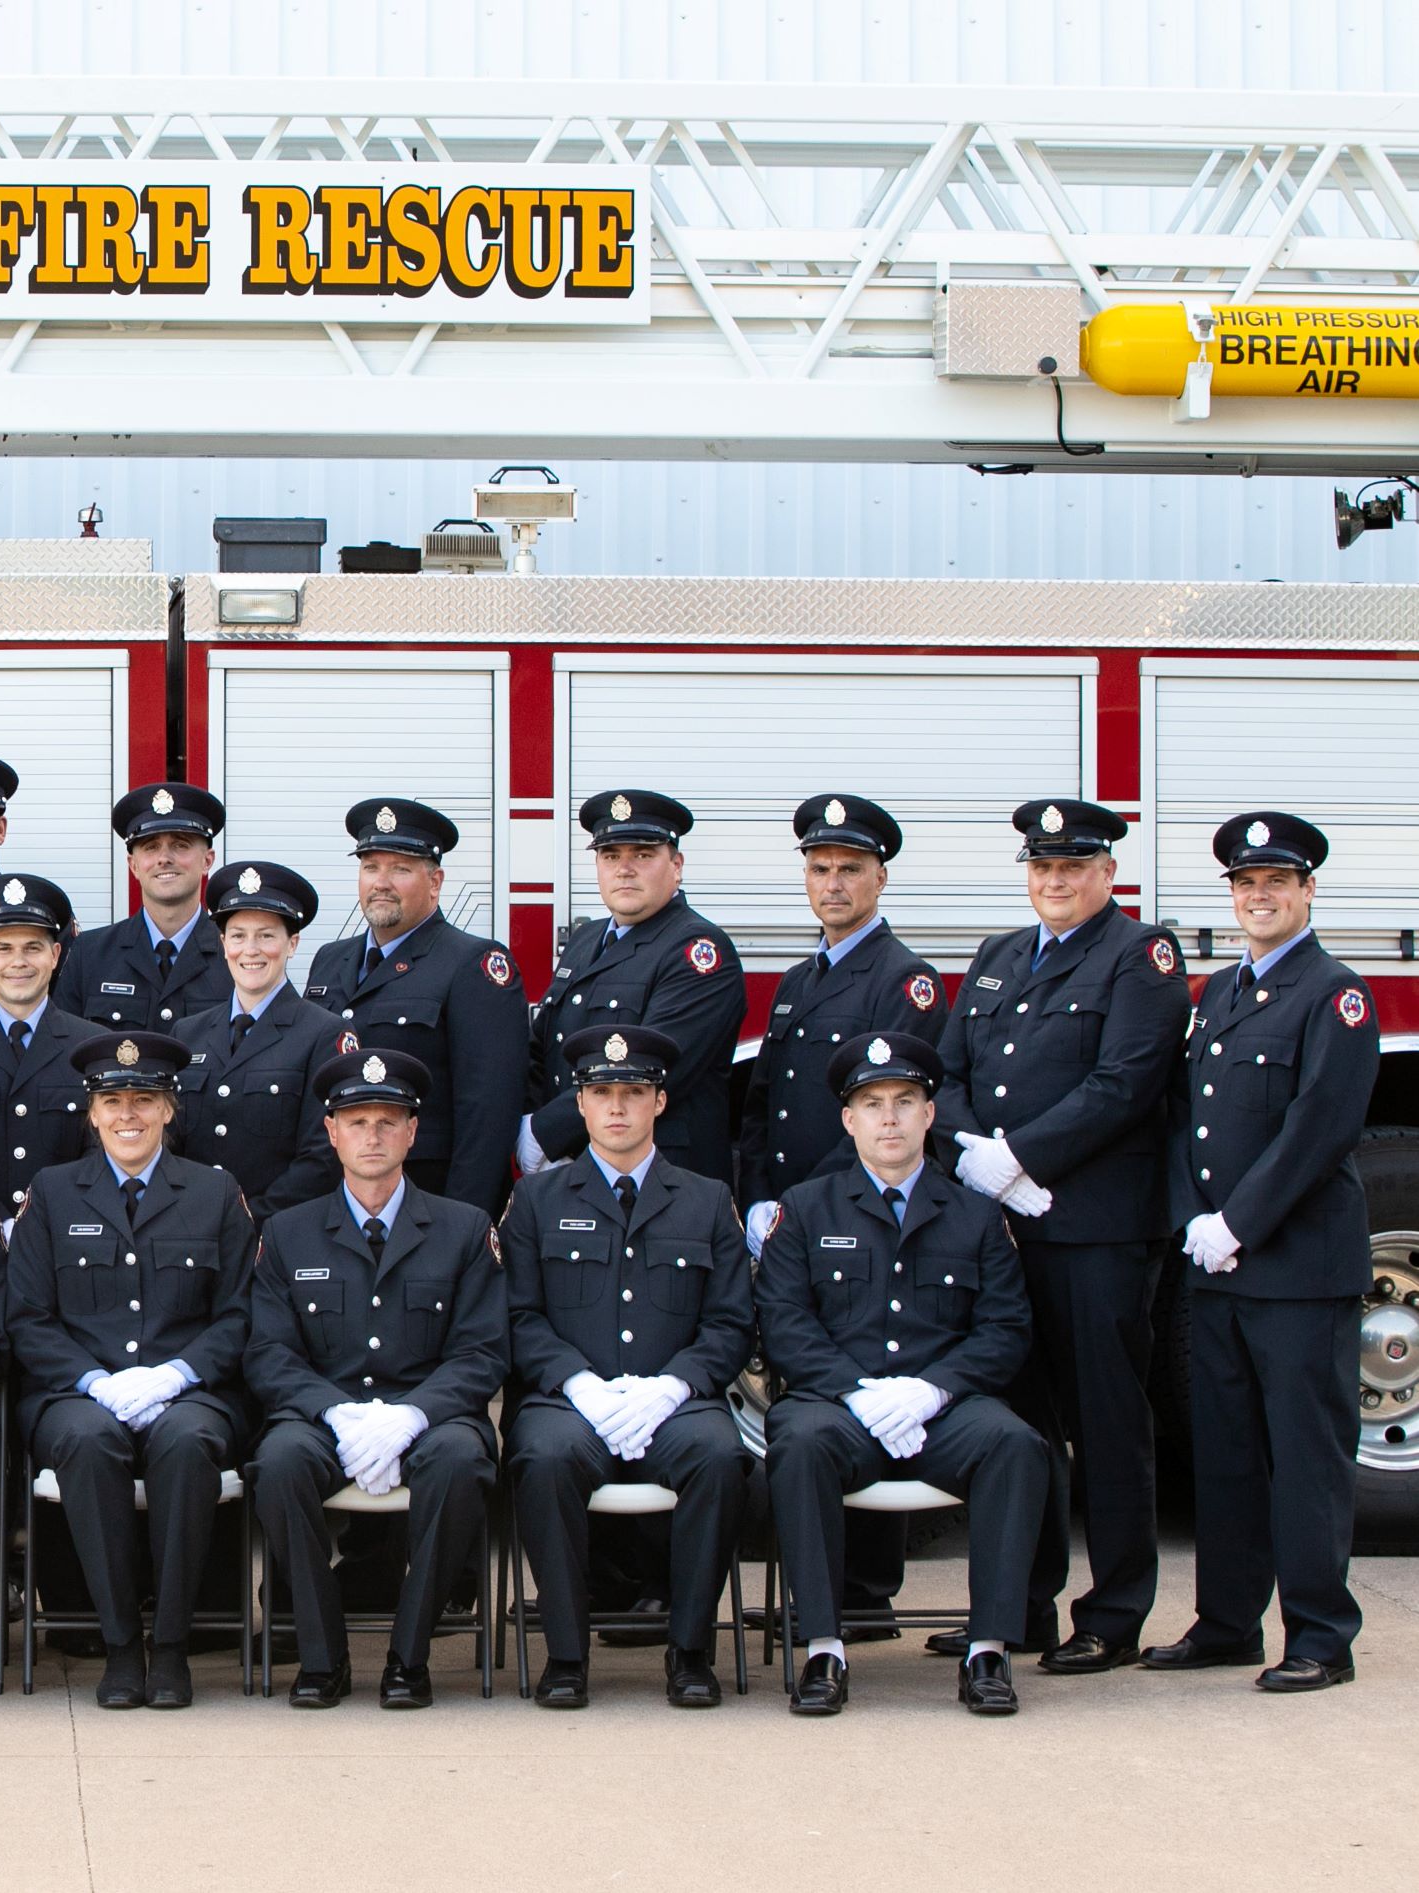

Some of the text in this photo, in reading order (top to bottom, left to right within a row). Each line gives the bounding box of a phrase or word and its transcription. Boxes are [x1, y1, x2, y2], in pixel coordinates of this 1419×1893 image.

[242, 185, 635, 300] RESCUE
[1219, 311, 1283, 327] HIGH
[1220, 333, 1419, 367] BREATHIN
[1295, 369, 1361, 394] AIR
